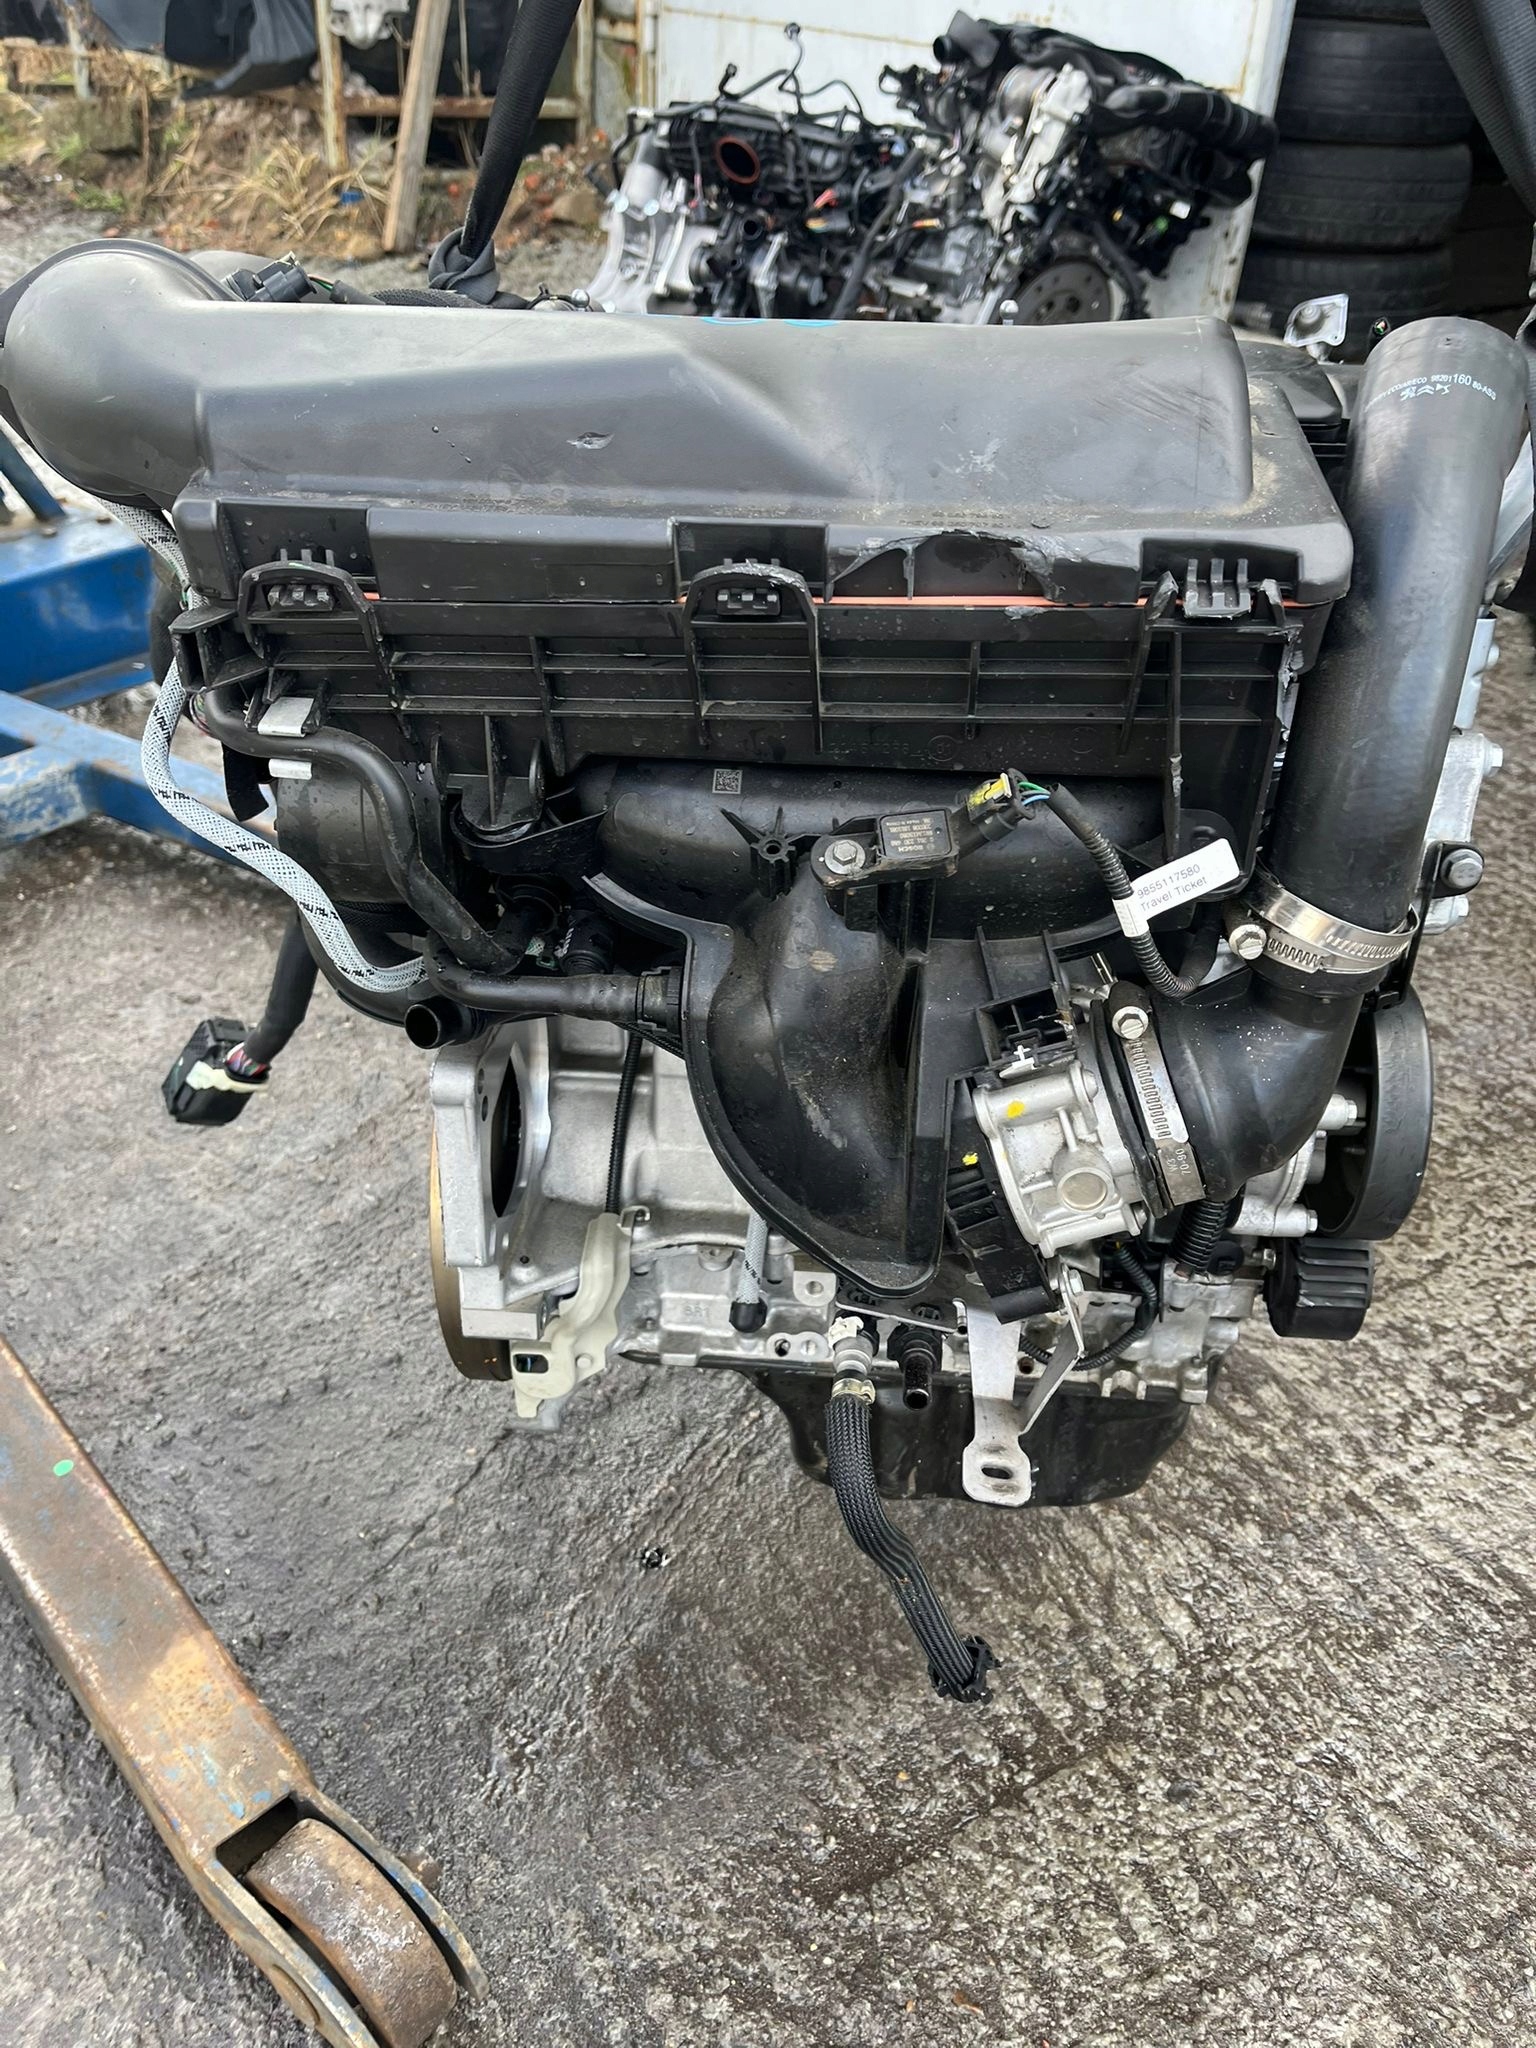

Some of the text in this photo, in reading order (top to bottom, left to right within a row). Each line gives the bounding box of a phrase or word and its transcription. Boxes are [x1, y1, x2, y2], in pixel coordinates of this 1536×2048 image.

[1453, 373, 1472, 386] 160
[1136, 863, 1201, 900] 9855117580
[1140, 876, 1208, 912] Travel Ticket
[1175, 1148, 1192, 1175] 70-90
